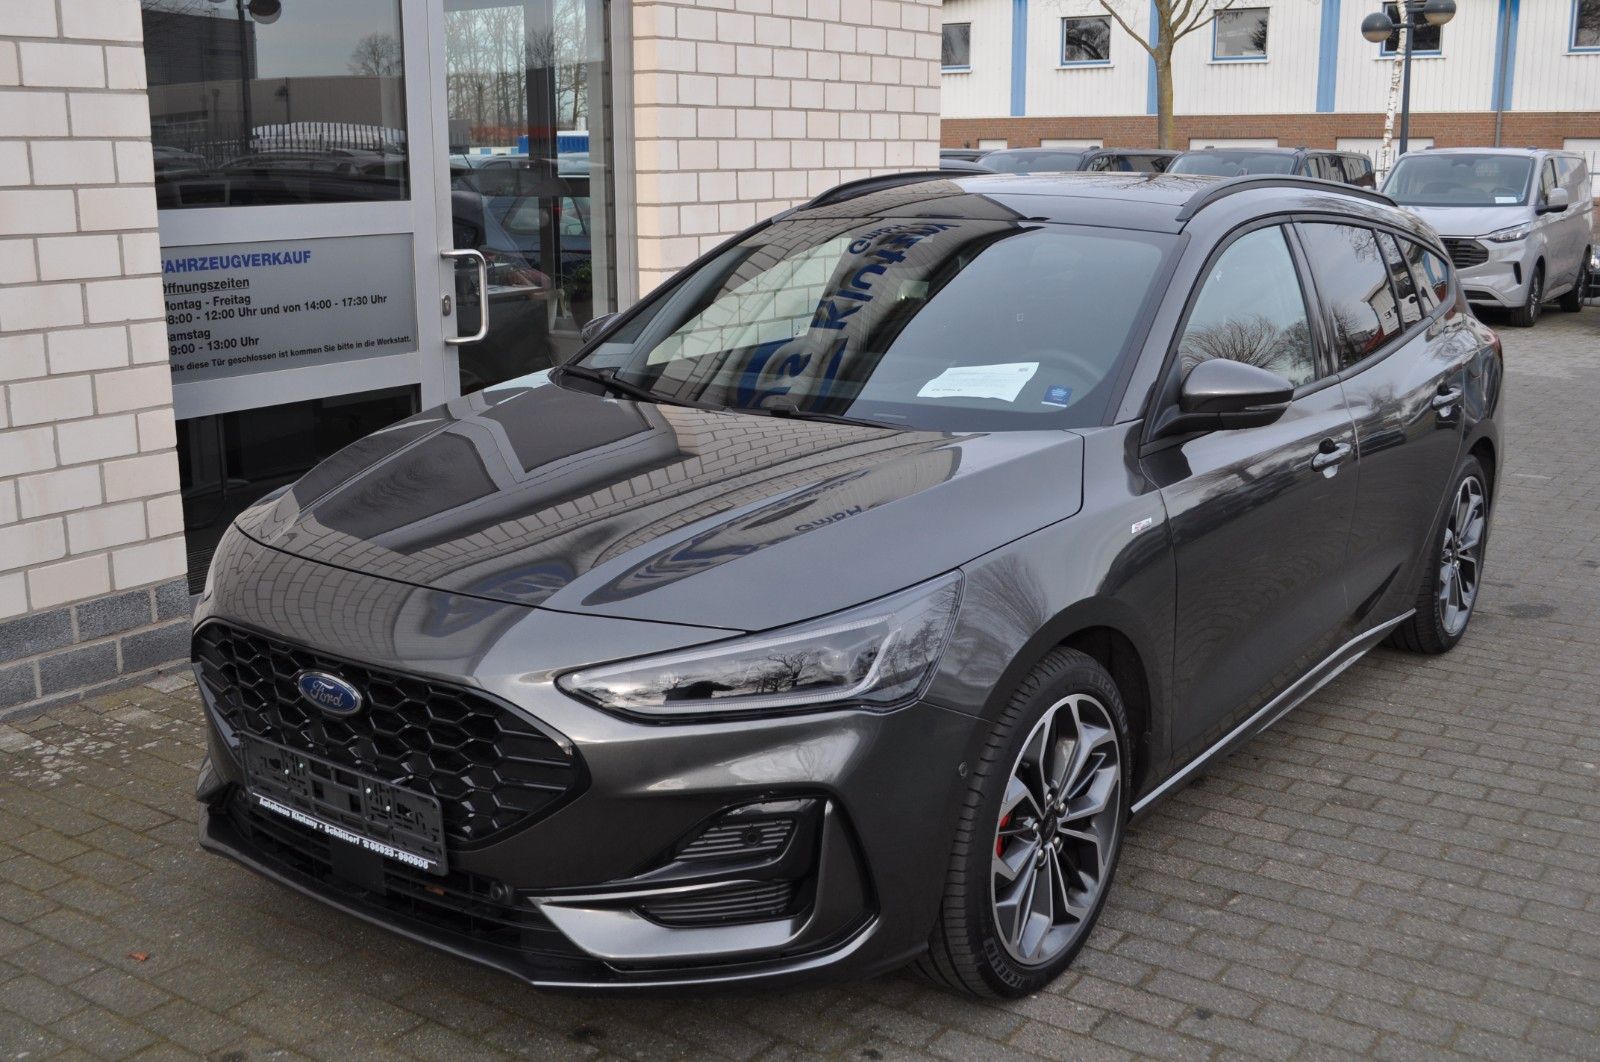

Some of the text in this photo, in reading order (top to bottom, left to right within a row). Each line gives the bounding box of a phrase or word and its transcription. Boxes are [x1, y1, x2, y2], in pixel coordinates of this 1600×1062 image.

[161, 250, 311, 273] AHRZEUGVERKAUF
[166, 313, 193, 325] 8:00
[205, 308, 234, 321] 12:00
[238, 307, 257, 317] Uhr
[260, 304, 280, 315] und
[283, 303, 301, 313] von
[304, 299, 332, 311] 14:00
[342, 296, 368, 307] 17:30
[371, 294, 387, 304] Uhr
[213, 295, 251, 306] Freitag
[168, 329, 211, 341] amstag
[169, 343, 195, 355] 9:00
[207, 338, 237, 351] 13:00
[240, 337, 259, 346] Uhr
[171, 363, 185, 372] alls
[186, 360, 209, 370] diese
[212, 358, 225, 367] Tür
[228, 351, 277, 366] geschlossen
[278, 350, 289, 358] ist
[290, 347, 322, 357] kommen
[324, 344, 335, 353] Sie
[337, 342, 354, 351] bitte
[355, 341, 363, 349] in
[364, 339, 375, 347] die
